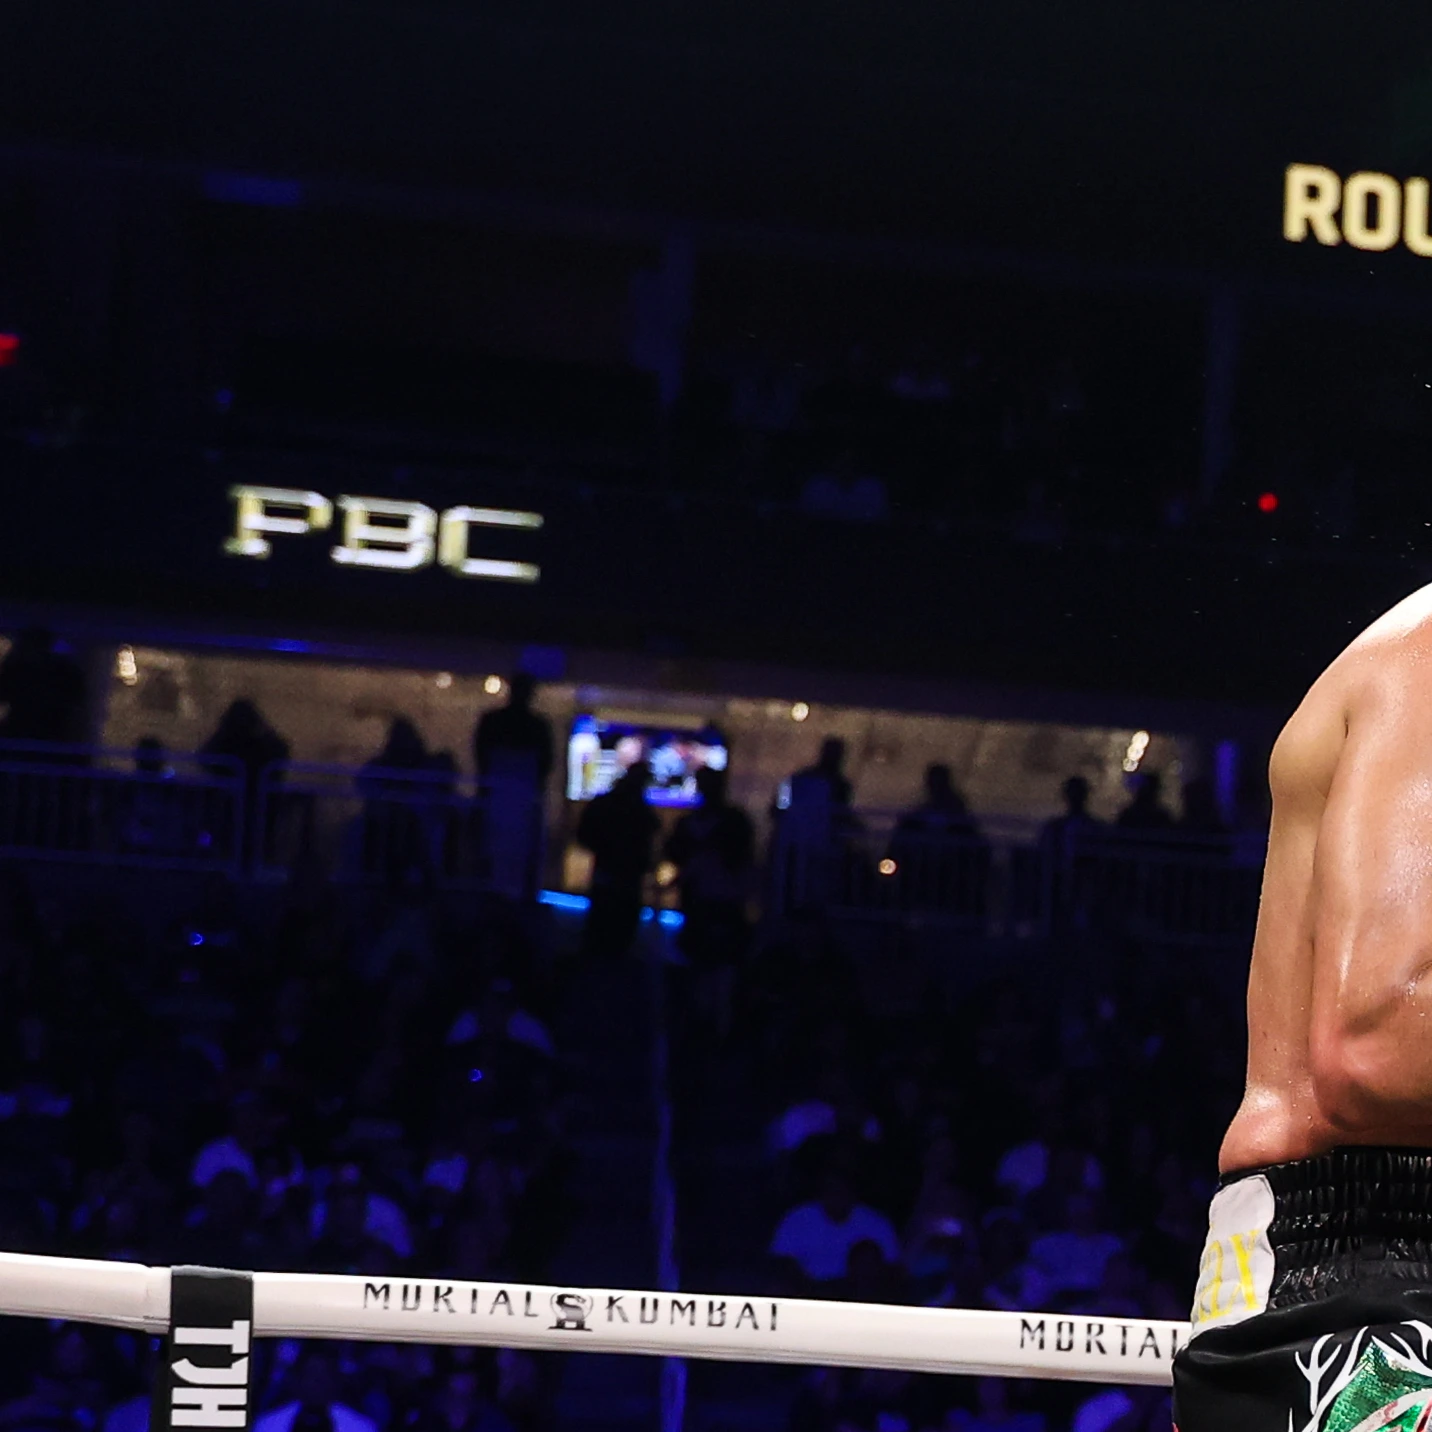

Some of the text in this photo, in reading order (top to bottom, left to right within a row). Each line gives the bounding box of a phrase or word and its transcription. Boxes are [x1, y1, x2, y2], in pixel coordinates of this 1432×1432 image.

[222, 483, 543, 582] PBC
[363, 1283, 779, 1332] MORTAL KOMBAT
[171, 1319, 250, 1428] TJH
